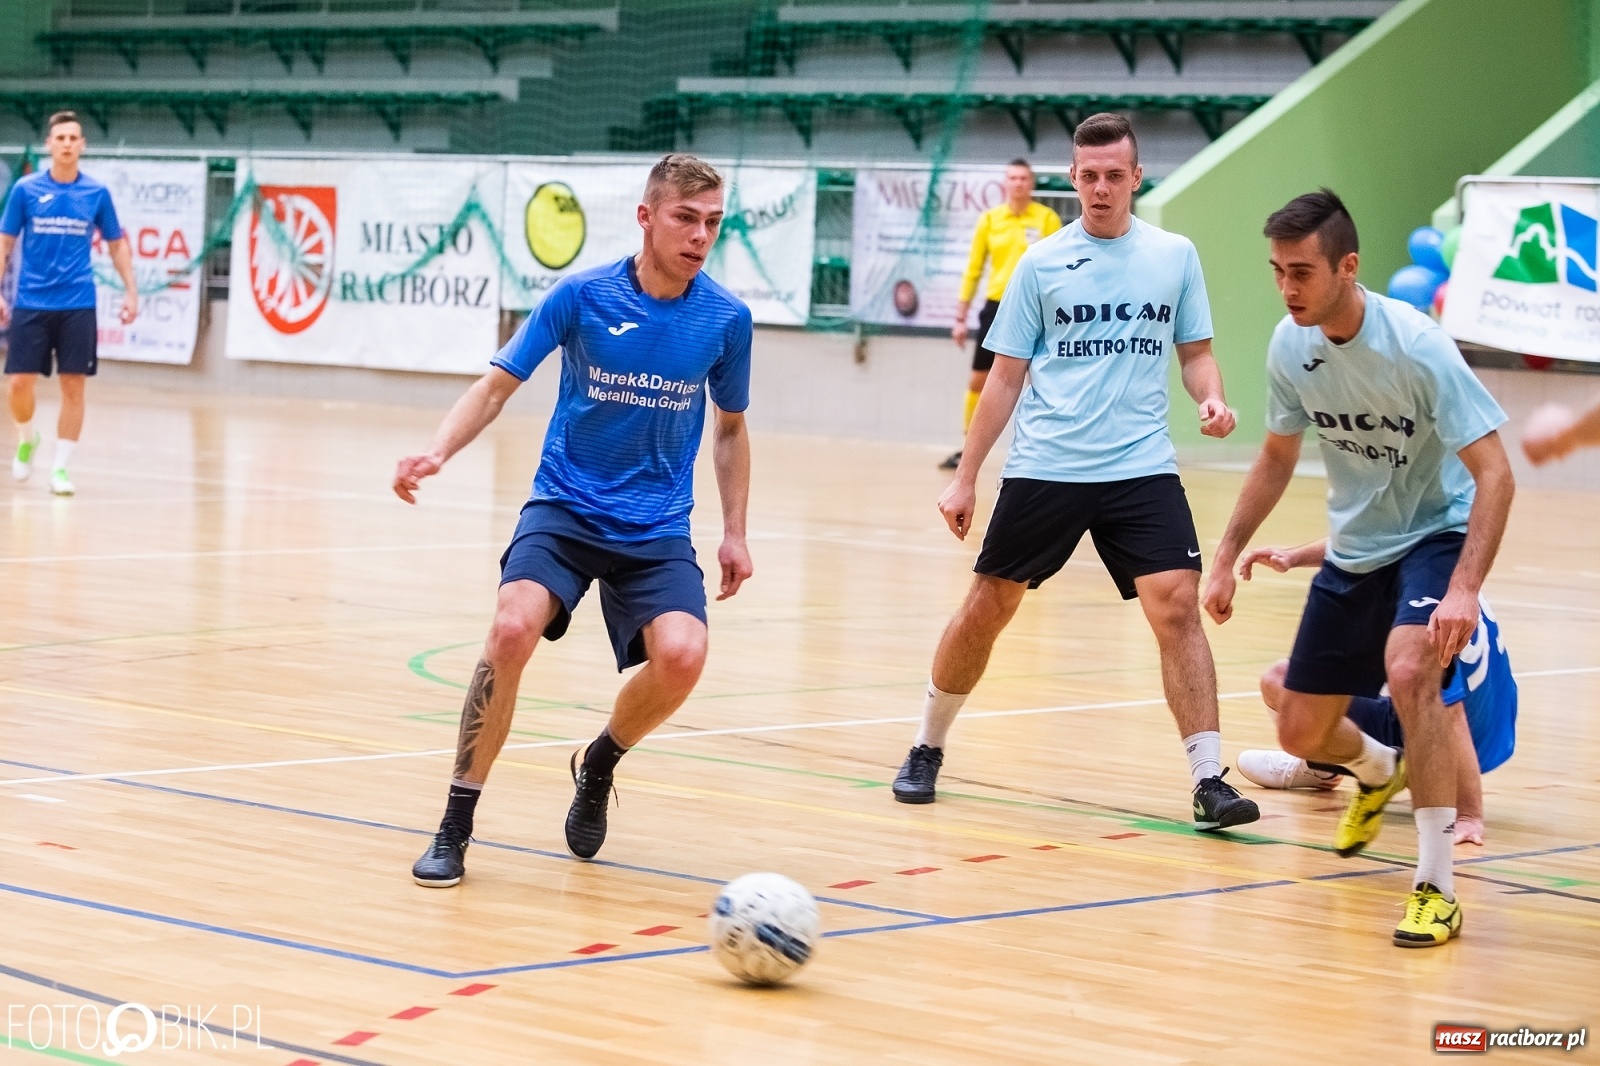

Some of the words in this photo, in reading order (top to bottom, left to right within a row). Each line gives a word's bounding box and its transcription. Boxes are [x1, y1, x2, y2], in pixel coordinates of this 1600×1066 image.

[359, 220, 473, 257] MIASTO
[340, 265, 491, 308] RACIBÓRZ
[1055, 302, 1171, 326] ADICAR
[1480, 289, 1561, 319] powiat
[587, 385, 656, 408] Metallbau
[1308, 410, 1415, 438] DICAR
